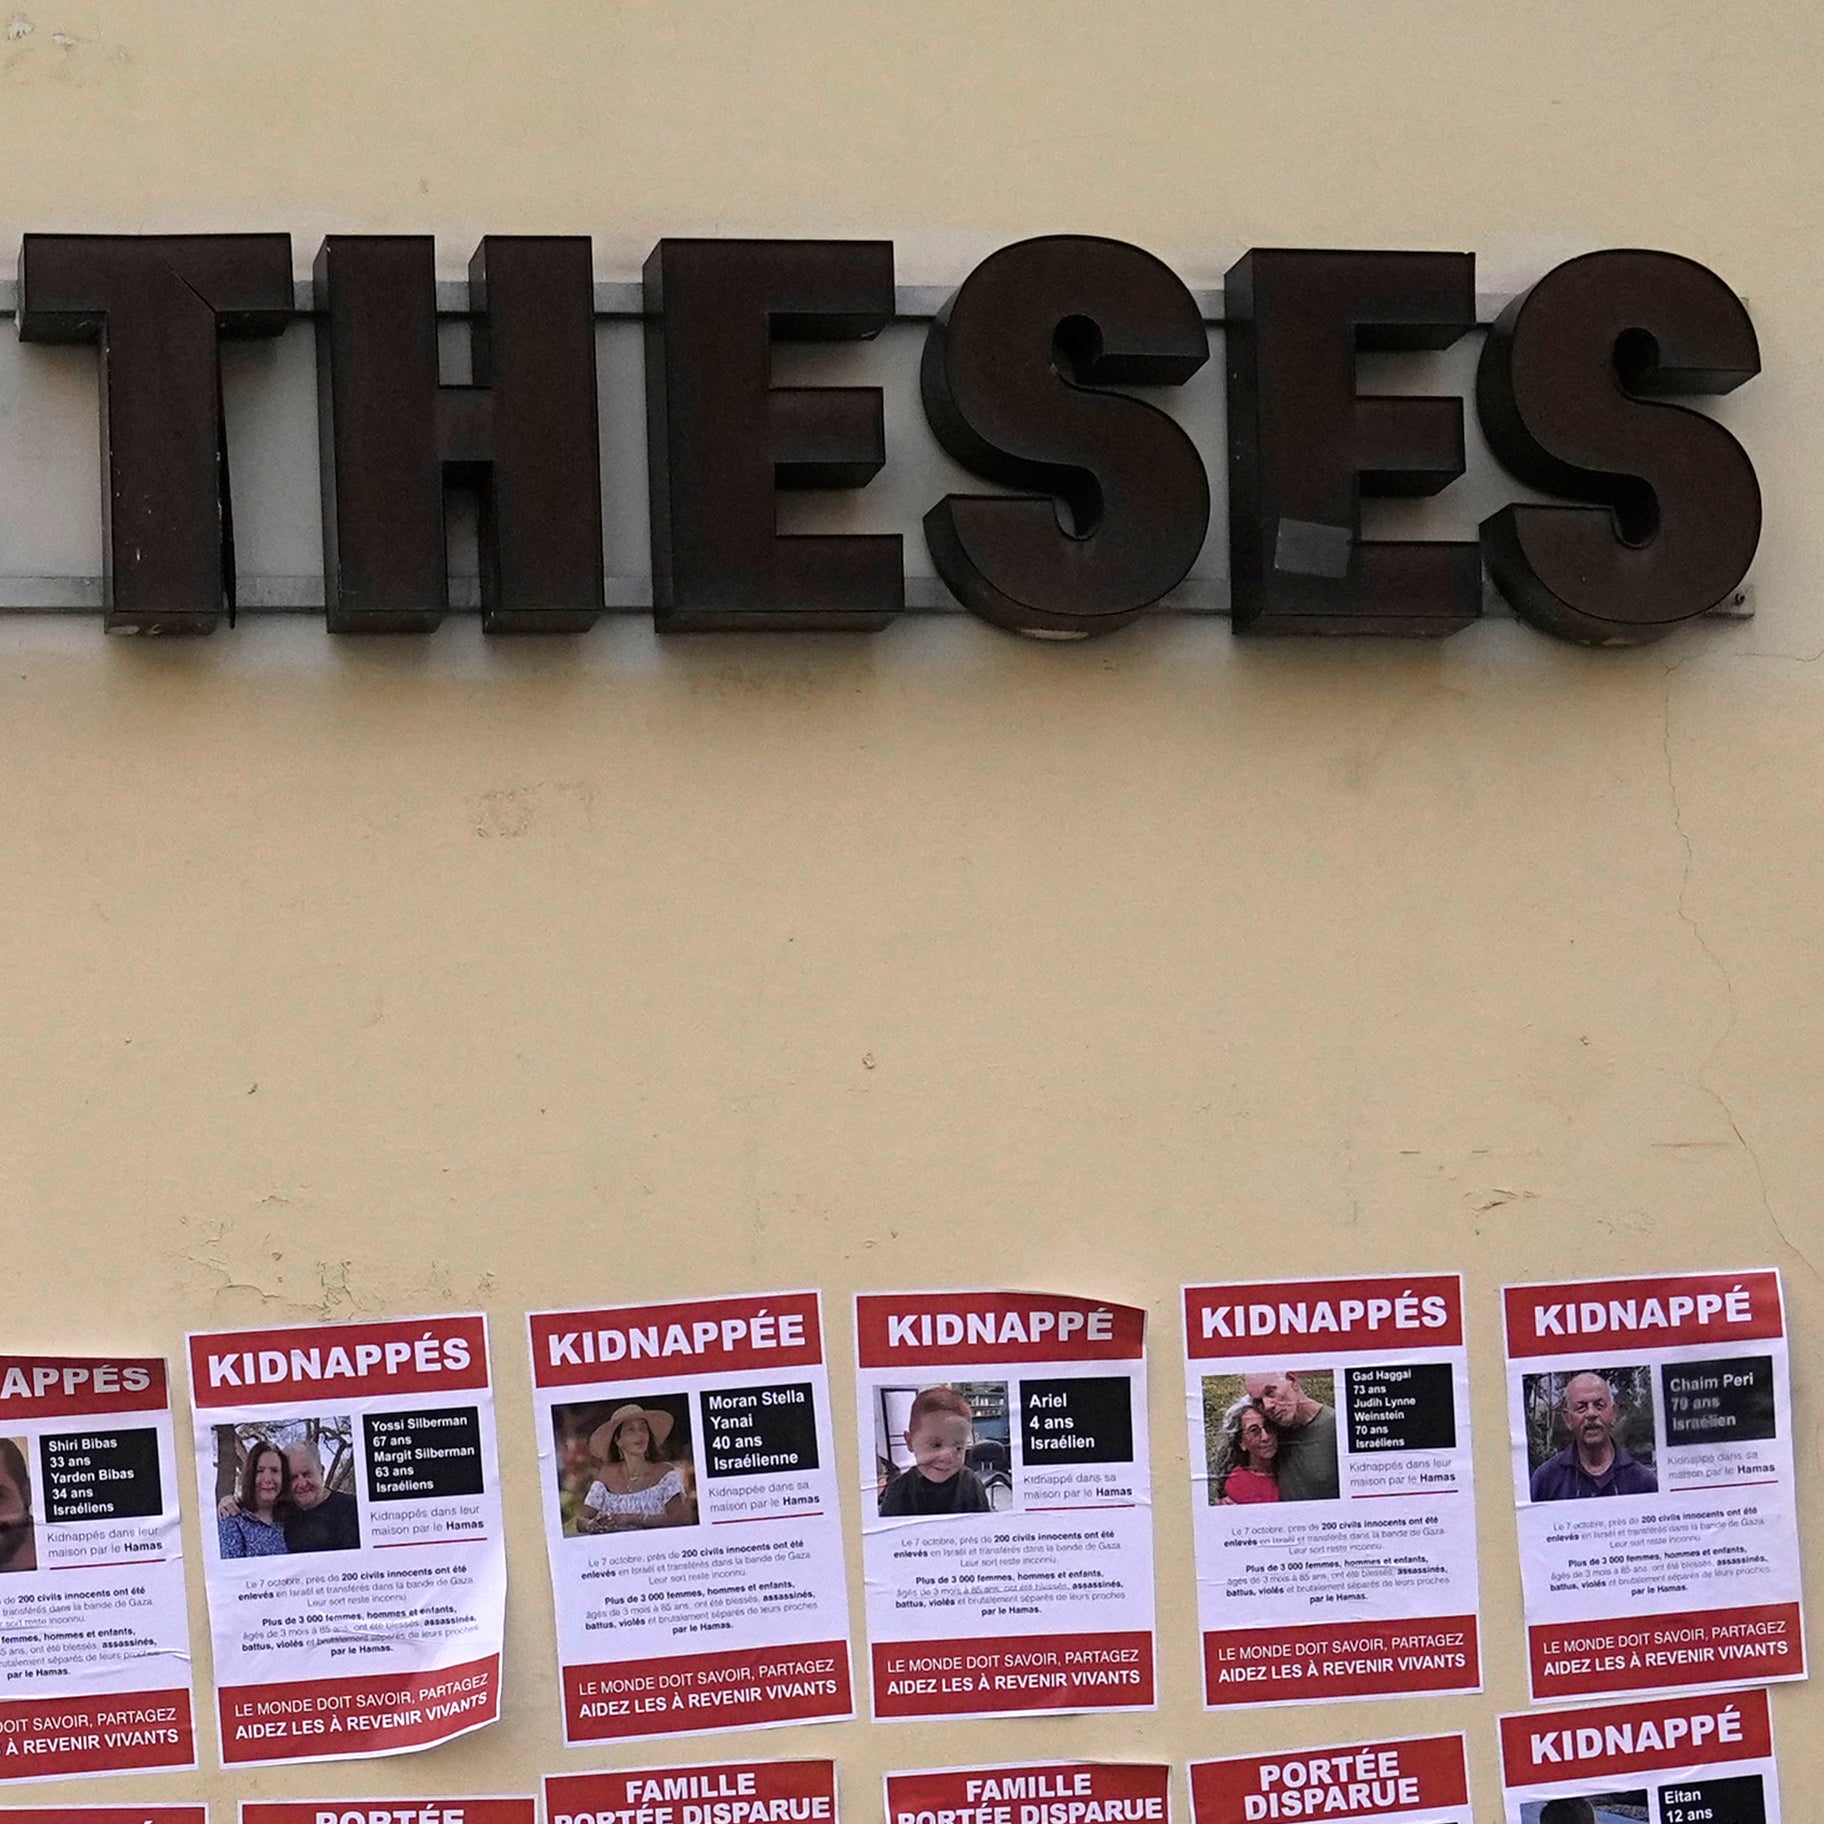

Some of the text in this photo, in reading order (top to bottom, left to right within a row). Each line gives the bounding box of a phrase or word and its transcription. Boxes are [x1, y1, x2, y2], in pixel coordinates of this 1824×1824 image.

[18, 232, 1763, 649] THESES
[1202, 1290, 1447, 1338] KIDNAPPÉS
[1535, 1285, 1751, 1336] KIDNAPPÉ
[549, 1309, 805, 1366] KIDNAPPÉE
[888, 1308, 1113, 1346] KIDNAPPÉ
[208, 1332, 470, 1387] KIDNAPPÉS
[709, 1390, 804, 1409] Moran Stella
[1030, 1393, 1066, 1408] Ariel
[710, 1414, 752, 1429] Yanai
[1030, 1416, 1073, 1429] 4 ans
[713, 1436, 762, 1449] 40 ans
[1031, 1435, 1094, 1449] Israélien
[715, 1453, 798, 1470] Israélienne
[888, 1650, 1138, 1672] LE MONDE DOIT SAVOIR, PARTAGEZ
[888, 1670, 1140, 1694] AIDEZ LES À REVENIR VIVANTS
[1531, 1704, 1742, 1764] KIDNAPPÉ
[1260, 1748, 1399, 1791] PORTÉE
[626, 1773, 756, 1803] FAMILLE
[967, 1774, 1091, 1802] FAMILLE
[1244, 1777, 1419, 1820] DISPARUE
[1665, 1791, 1701, 1804] Eitan
[1667, 1809, 1712, 1823] 12 ans
